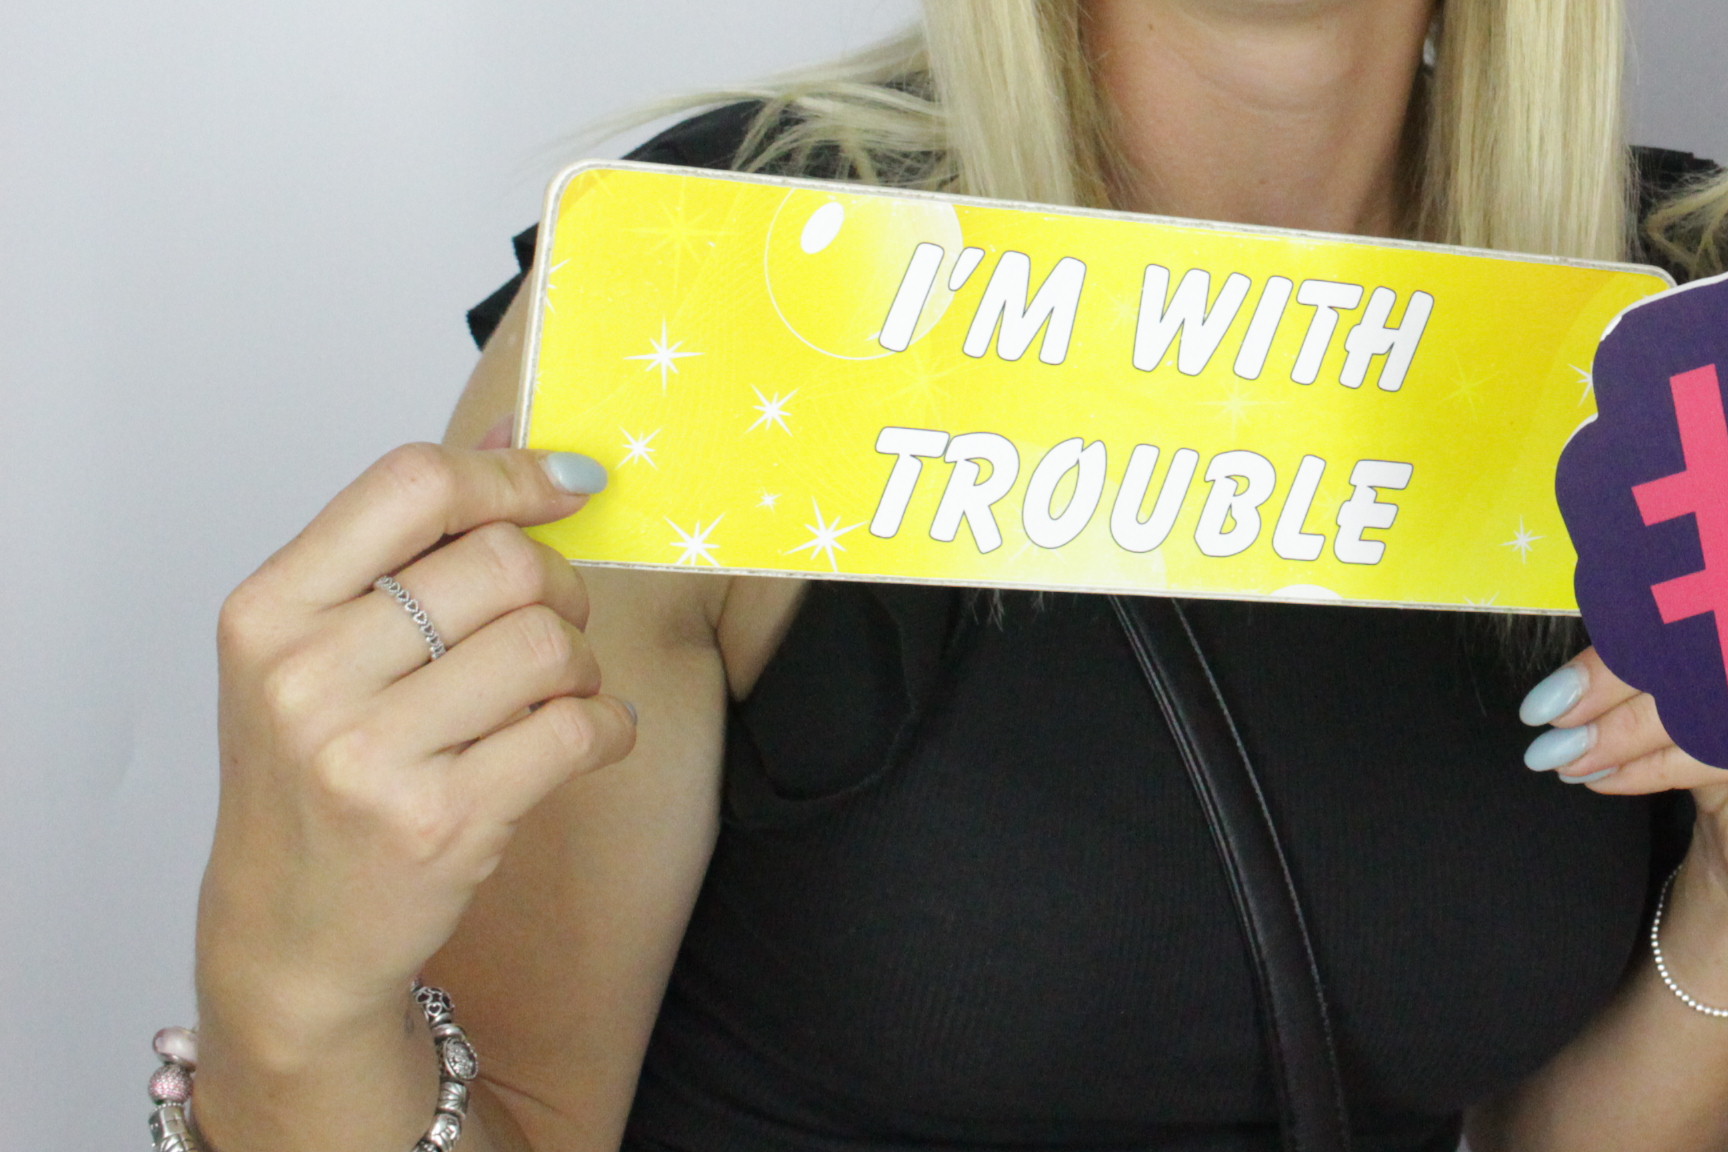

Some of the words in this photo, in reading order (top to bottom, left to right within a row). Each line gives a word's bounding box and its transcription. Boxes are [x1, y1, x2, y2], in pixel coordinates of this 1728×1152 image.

[879, 243, 1087, 365] I'M
[1132, 265, 1434, 392] WITH
[869, 427, 1413, 565] TROUBLE
